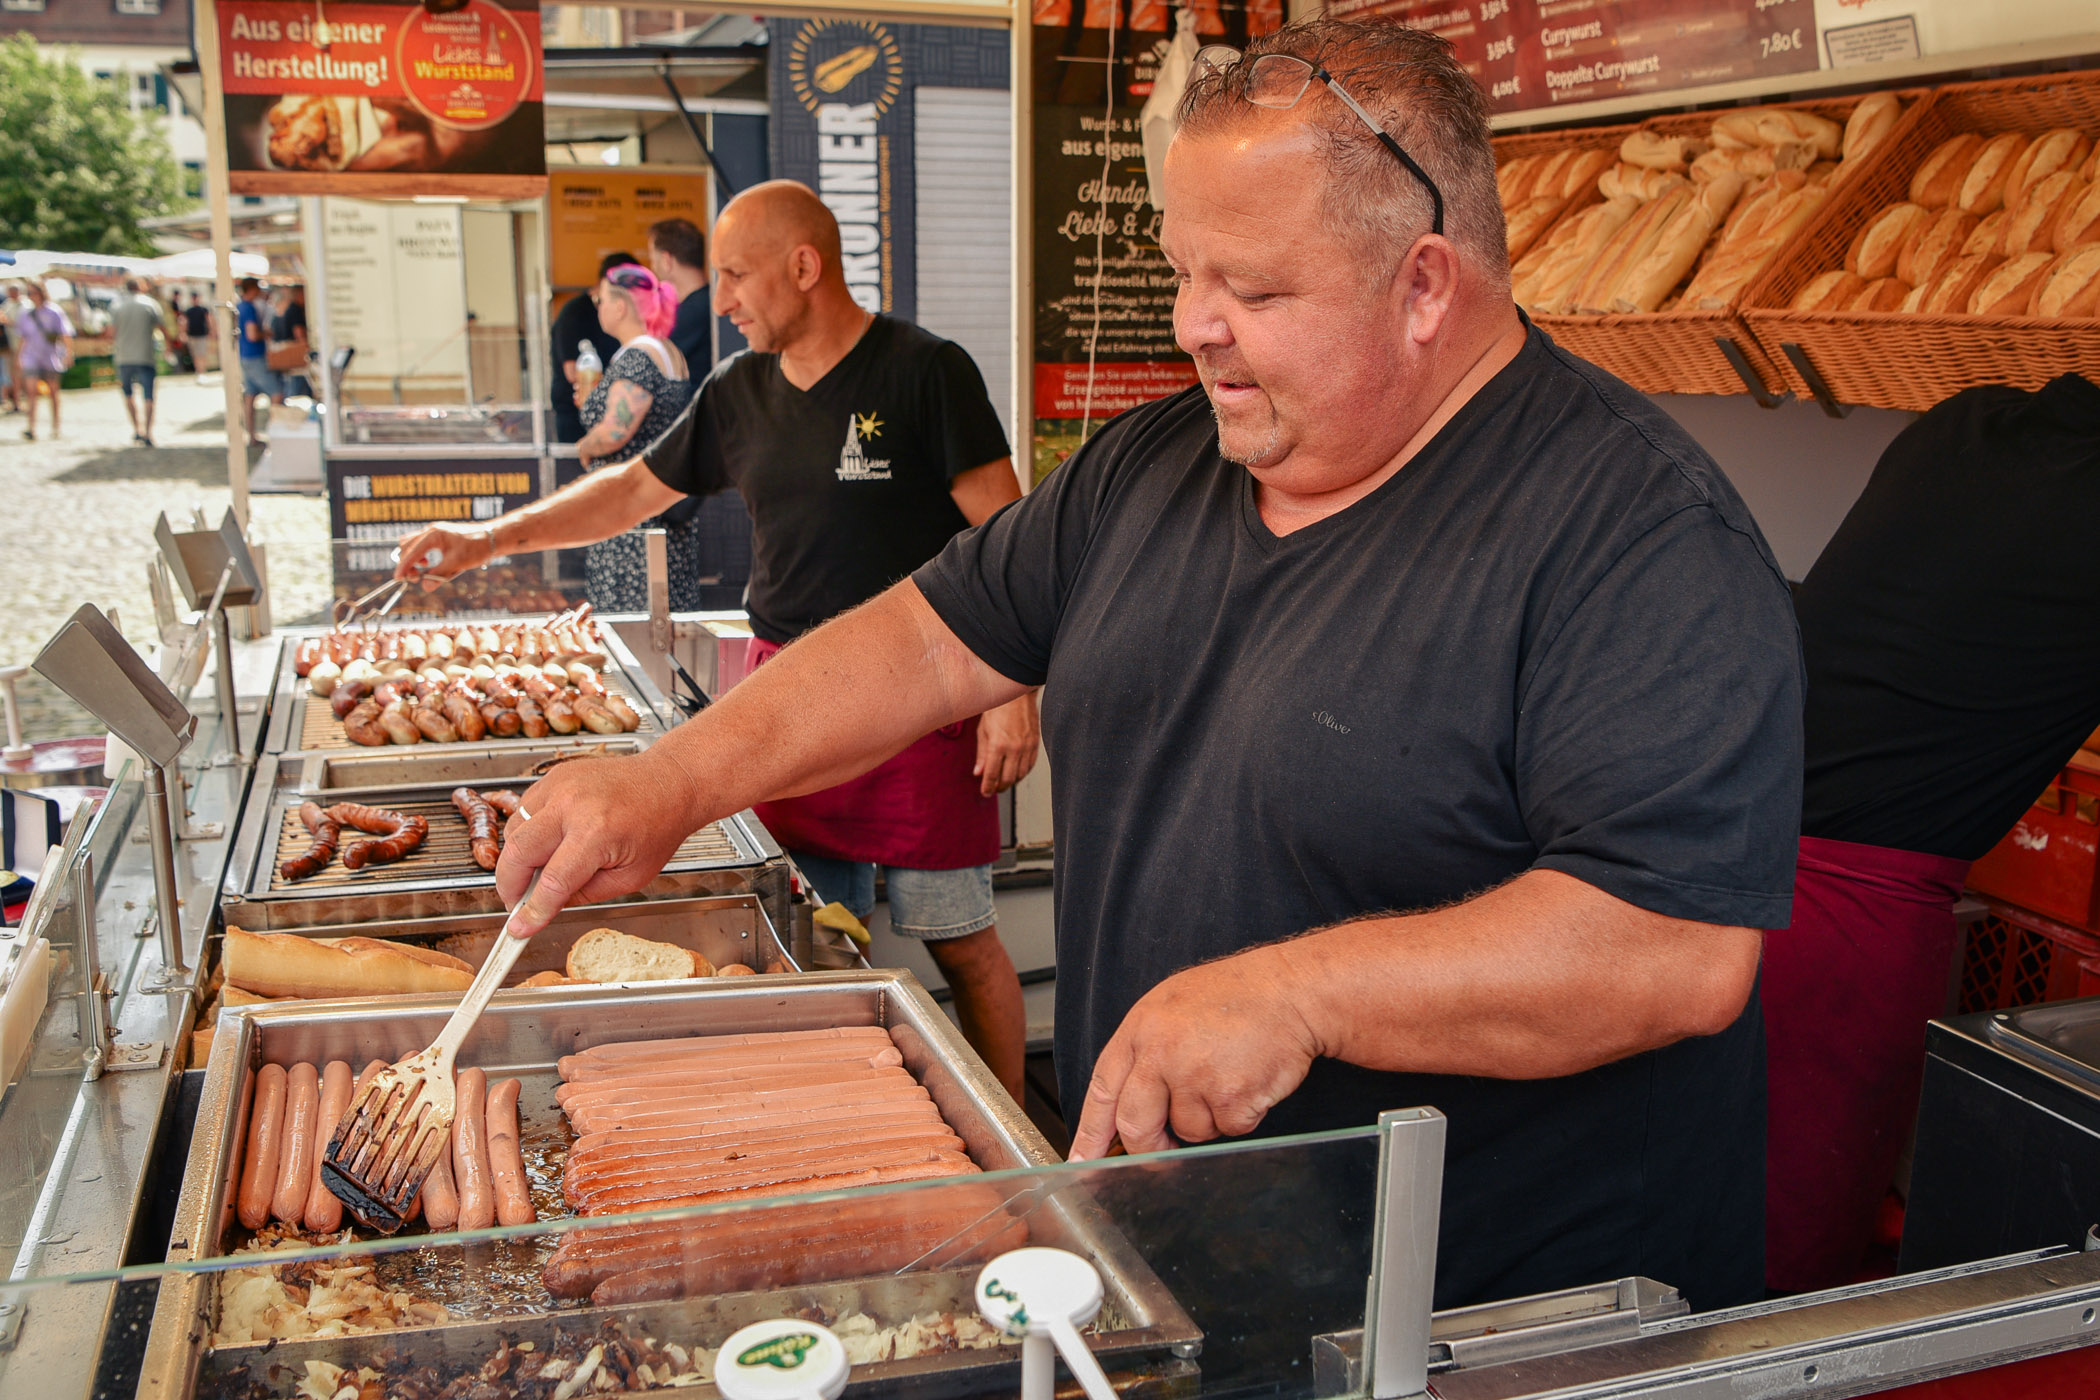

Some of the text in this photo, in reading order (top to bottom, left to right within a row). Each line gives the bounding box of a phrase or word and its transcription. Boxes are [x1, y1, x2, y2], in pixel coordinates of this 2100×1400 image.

[231, 13, 282, 42] Aus
[1541, 19, 1603, 48] Currywurst
[1760, 28, 1802, 58] 7.80€
[233, 51, 388, 87] Herstellung!
[413, 60, 514, 81] Wurststand
[1545, 64, 1595, 89] Doppelte
[1595, 54, 1660, 82] Currywurst
[1122, 118, 1131, 132] &
[1062, 140, 1145, 161] aus egen
[1058, 210, 1118, 241] Liebe
[1122, 212, 1138, 235] &
[1074, 274, 1147, 288] tradtionelle
[1064, 369, 1105, 380] Genieen
[1063, 382, 1126, 398] Erzegnisse
[1076, 397, 1135, 412] hemischen
